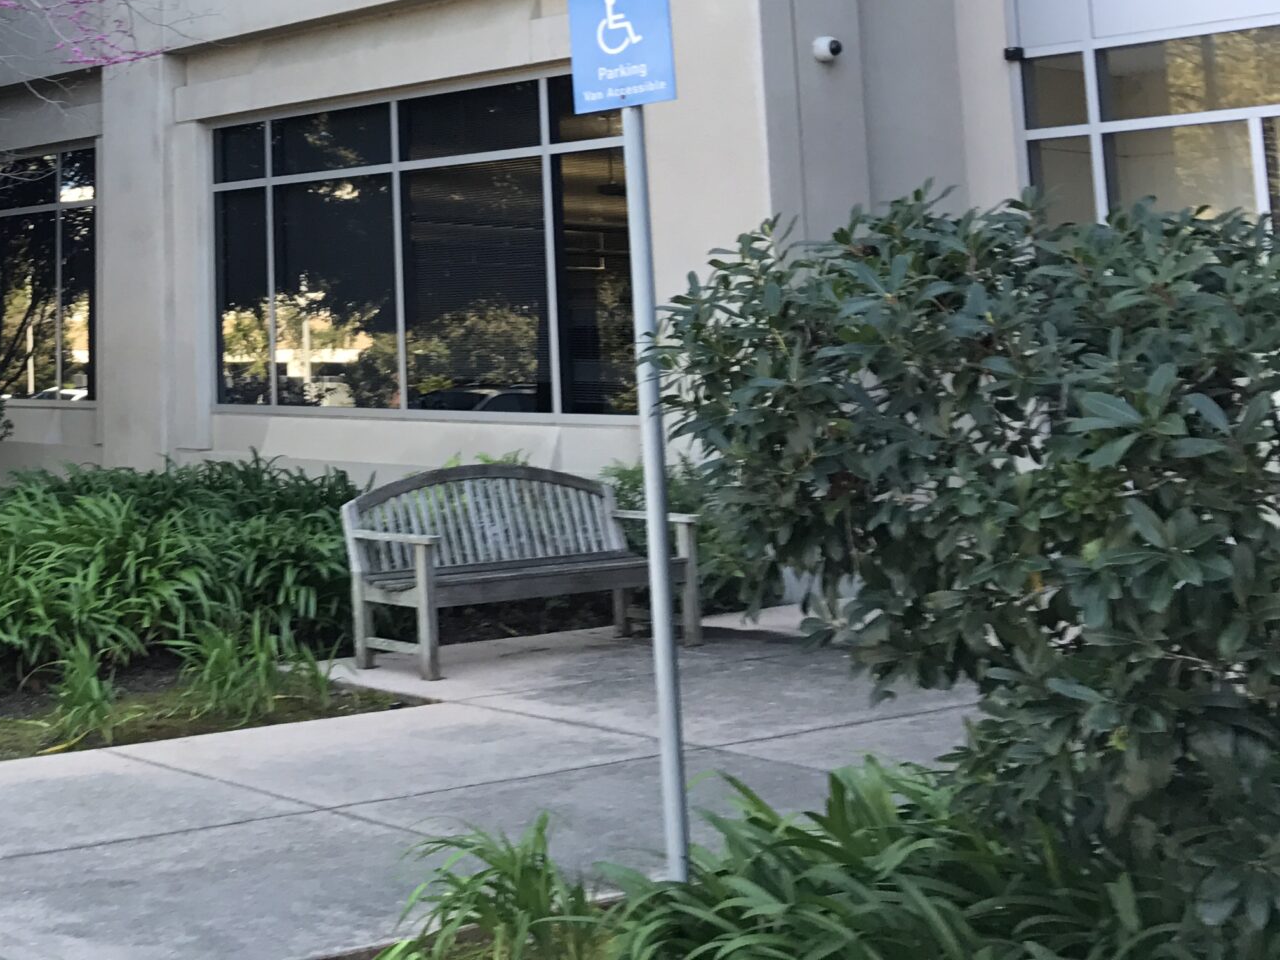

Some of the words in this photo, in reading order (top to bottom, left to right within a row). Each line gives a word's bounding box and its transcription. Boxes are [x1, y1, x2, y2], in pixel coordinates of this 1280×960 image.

[598, 64, 647, 80] Parking
[584, 91, 603, 101] Van
[607, 80, 666, 96] Accessible
